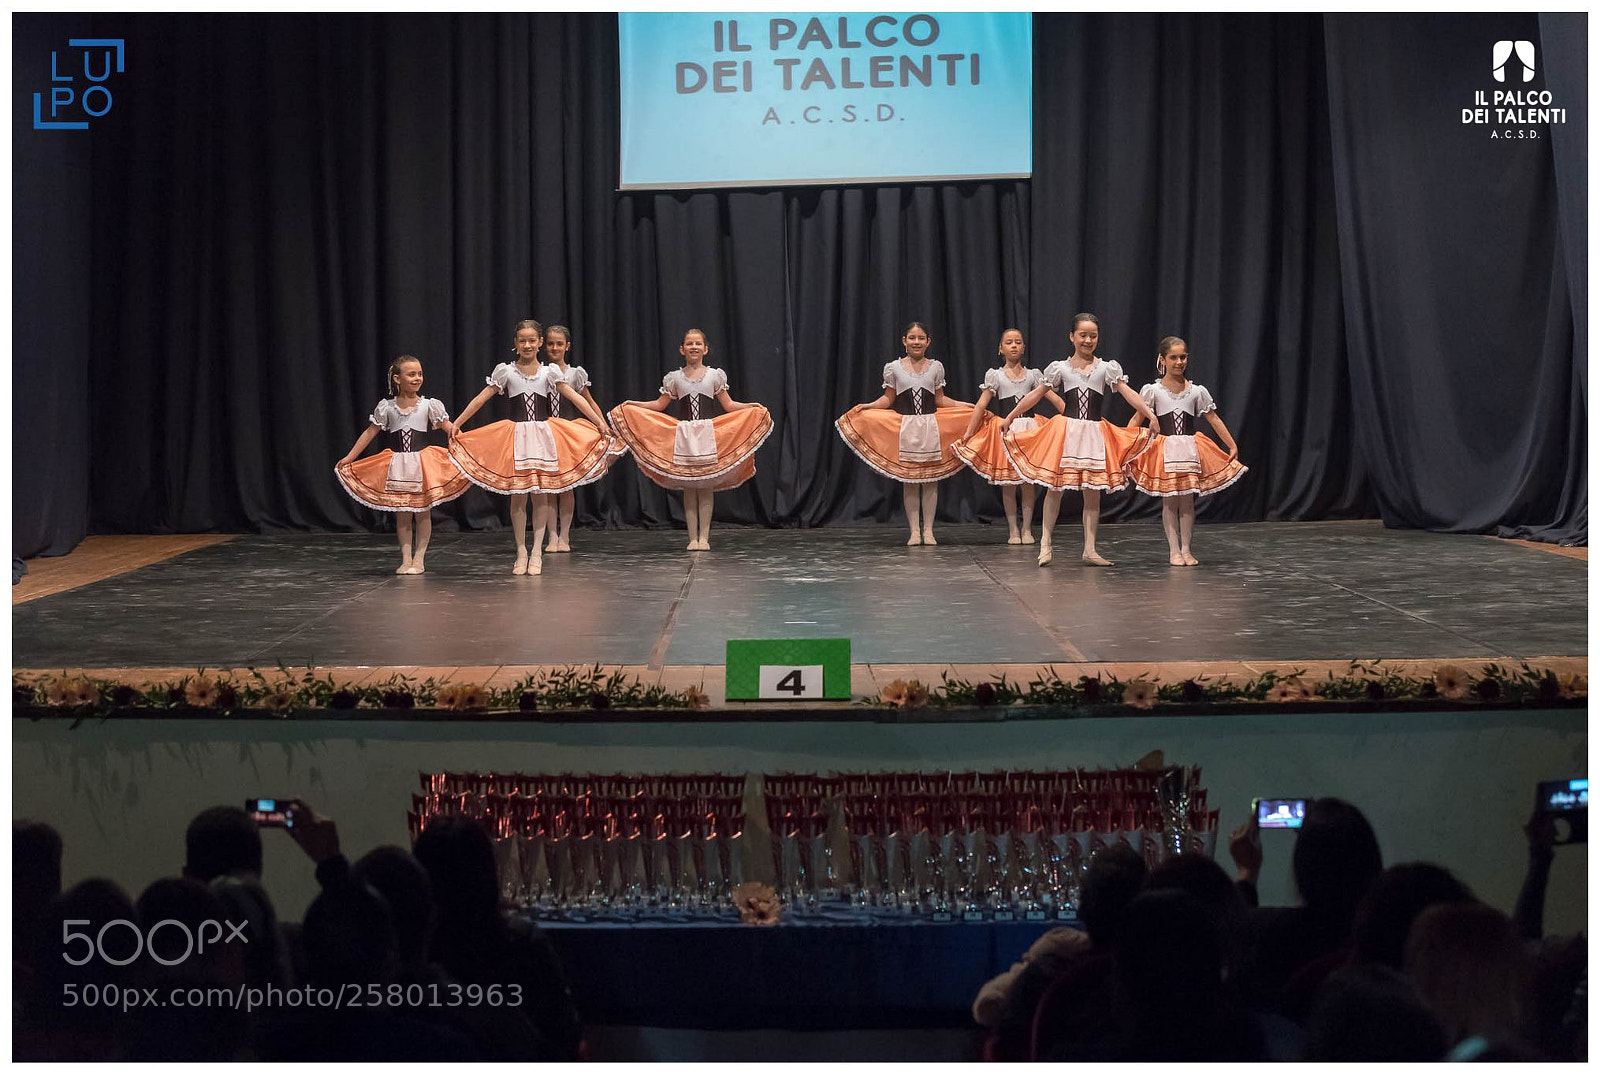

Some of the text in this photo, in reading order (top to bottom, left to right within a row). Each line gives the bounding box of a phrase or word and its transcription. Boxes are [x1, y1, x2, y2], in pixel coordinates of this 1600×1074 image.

[714, 14, 940, 52] IL PALCO
[675, 53, 980, 94] DEI TALENTI
[776, 670, 806, 696] 4
